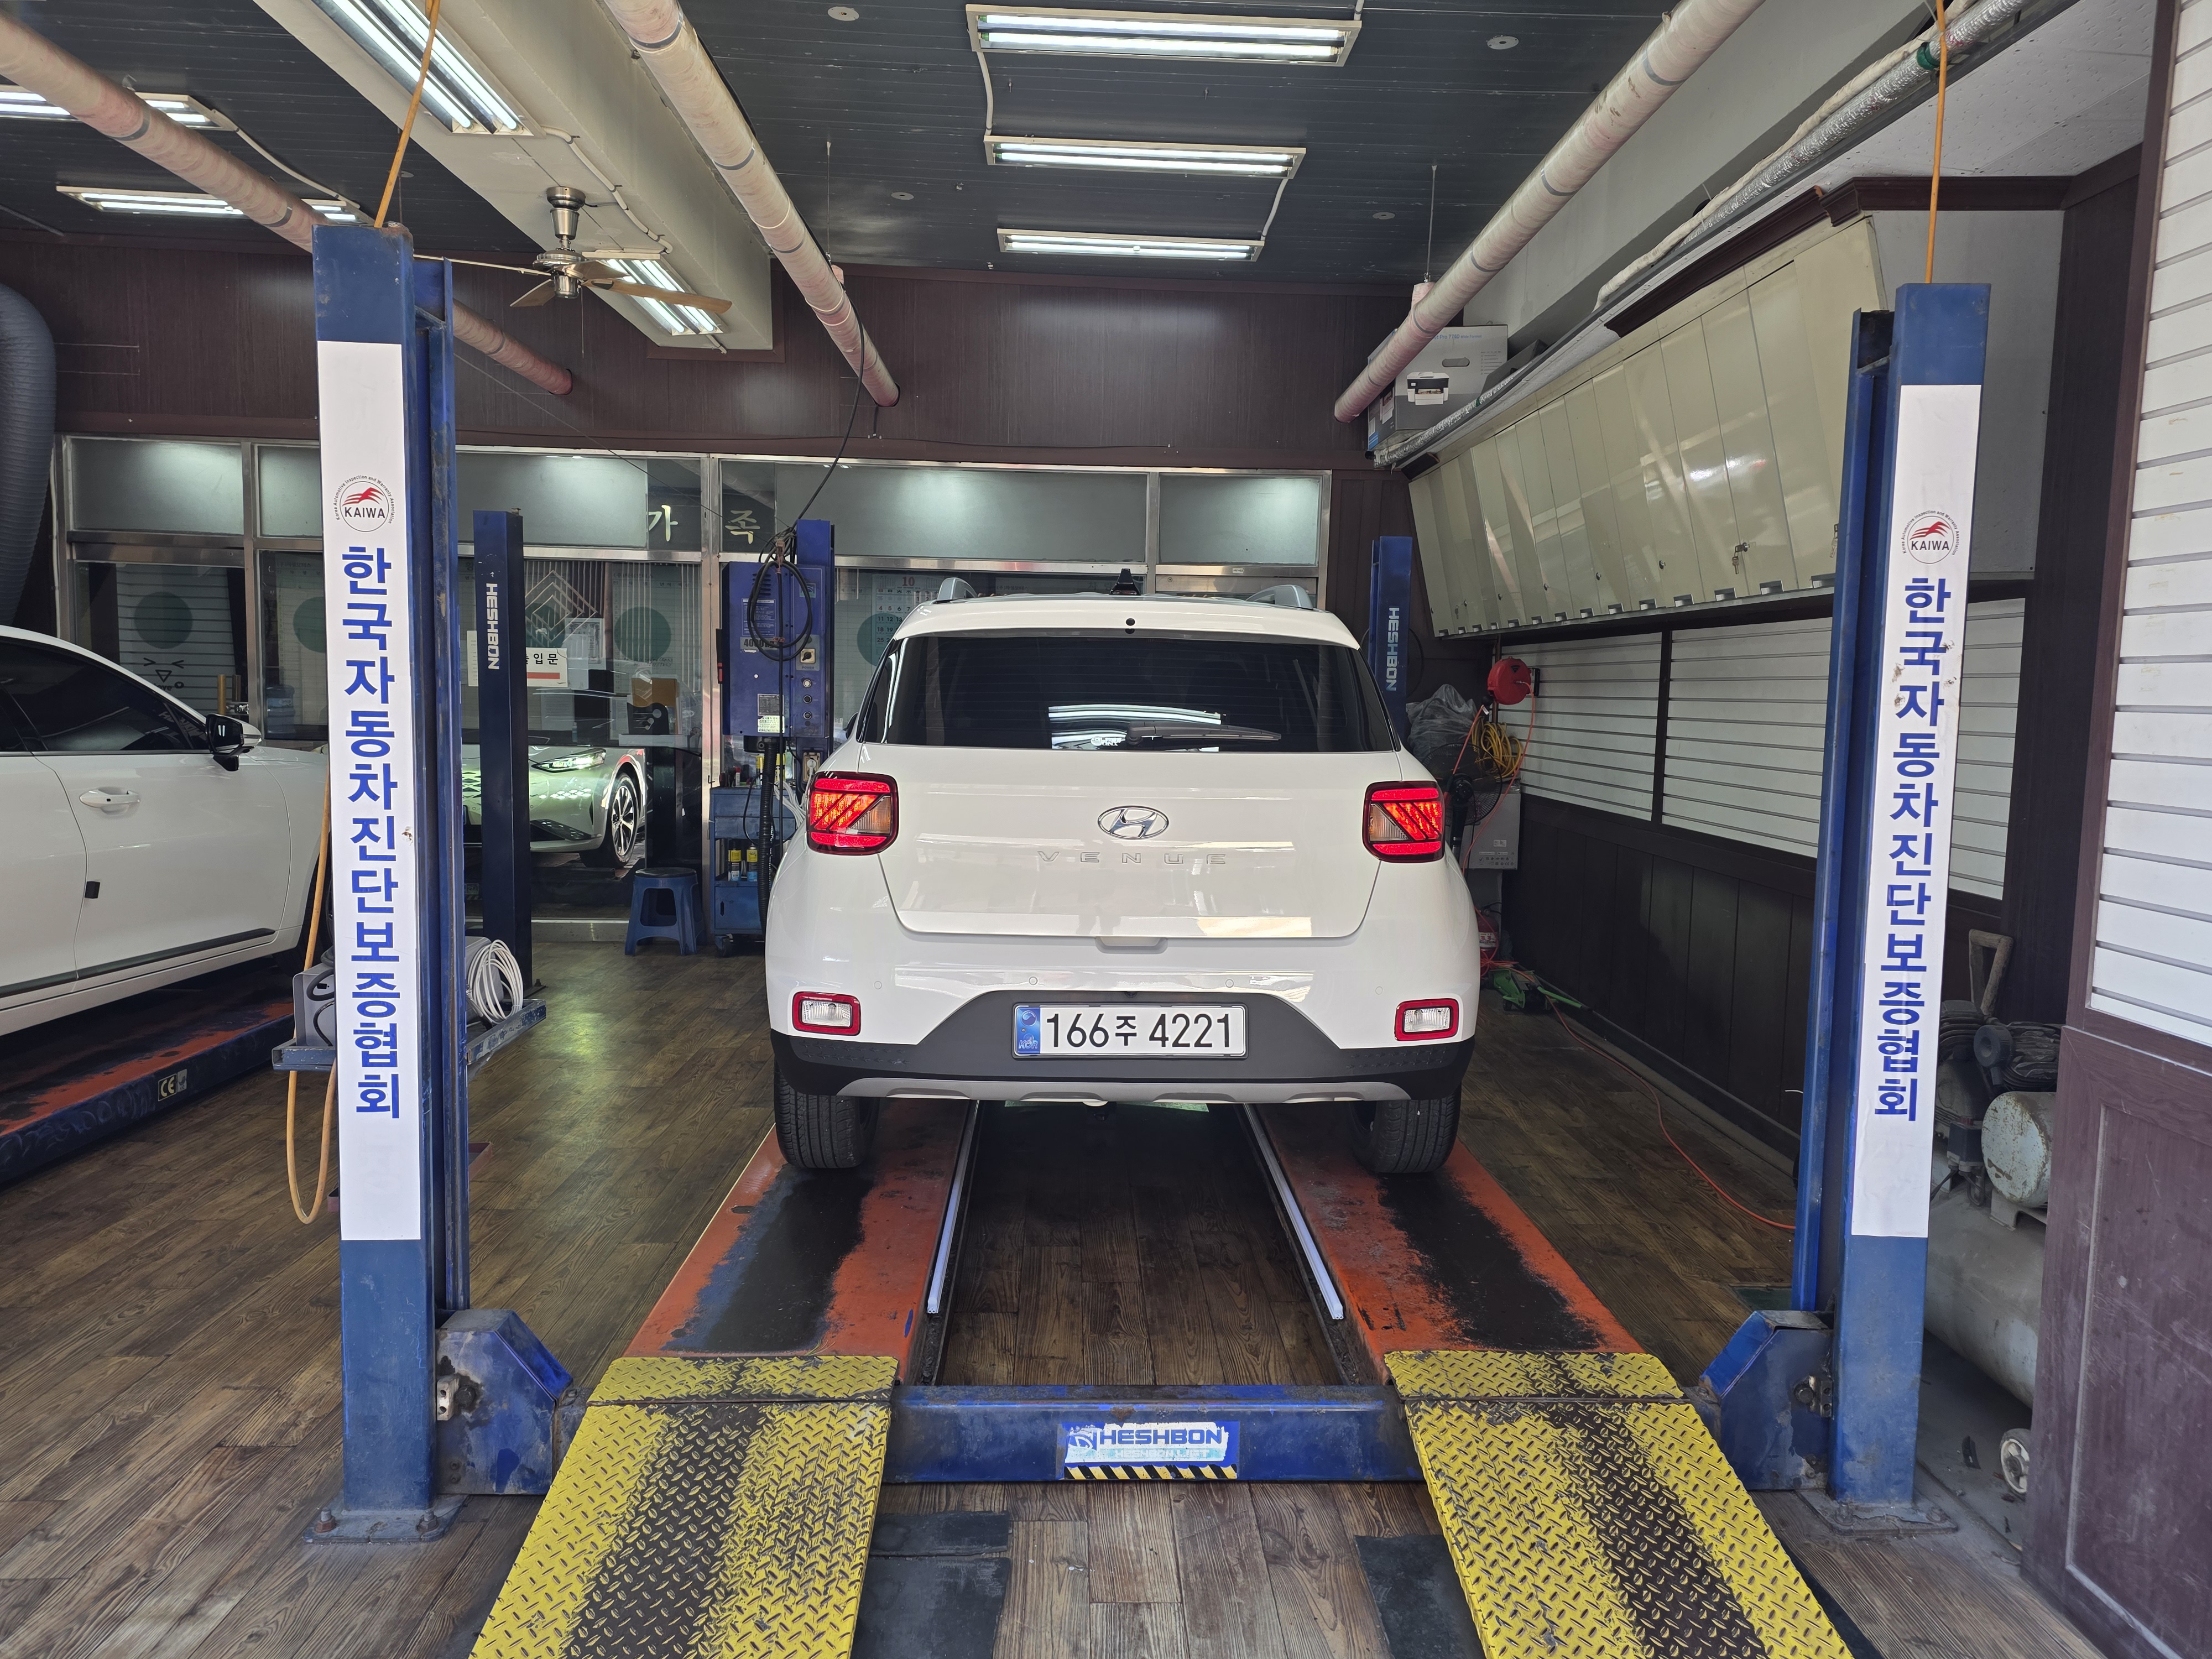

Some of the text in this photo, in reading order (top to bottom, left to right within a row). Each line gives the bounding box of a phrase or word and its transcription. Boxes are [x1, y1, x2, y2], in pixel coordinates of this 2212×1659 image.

[333, 483, 346, 506] Automotive
[345, 475, 367, 484] Inspection
[377, 479, 392, 497] Warranty
[344, 507, 385, 519] KAIWA
[649, 504, 679, 542] 가
[724, 510, 761, 544] 족
[1901, 518, 1915, 540] Automotive
[1914, 510, 1936, 519] Inspection
[1944, 513, 1958, 530] Warranty
[1911, 540, 1950, 551] KAIWA
[902, 576, 915, 587] 10
[486, 583, 500, 670] HESHBON
[1386, 607, 1400, 691] HESHBON
[342, 546, 400, 1119] 한국자동차진단보증협회
[1037, 851, 1225, 864] VENUE
[1875, 577, 1952, 1121] 한국자동차진단보증협회
[1018, 1040, 1039, 1049] KOR
[1046, 1013, 1230, 1048] 166주 4221
[1099, 1429, 1222, 1444] HESHBON
[1115, 1449, 1175, 1458] HESHBON
